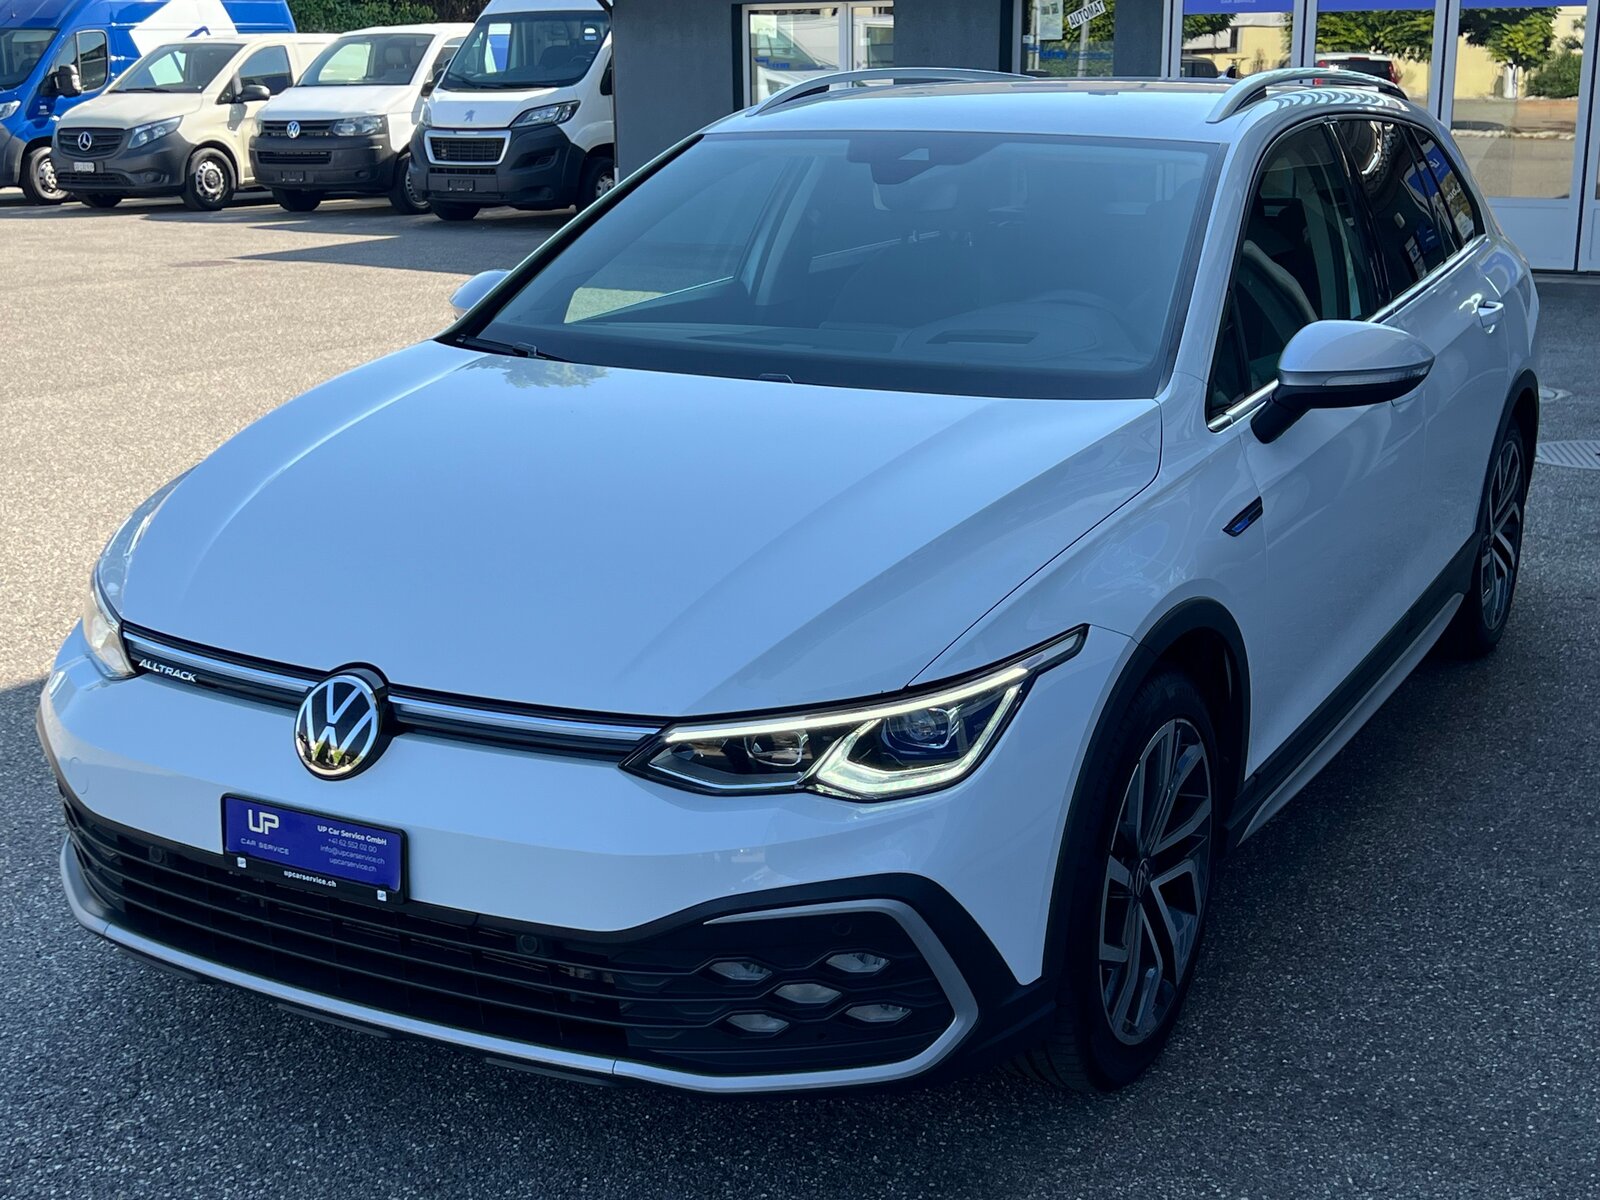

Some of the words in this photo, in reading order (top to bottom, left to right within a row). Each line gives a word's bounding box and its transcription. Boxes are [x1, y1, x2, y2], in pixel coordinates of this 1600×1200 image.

[1069, 0, 1104, 27] AUTOMAT
[139, 659, 197, 682] ALLTRACK
[248, 809, 279, 835] UP
[317, 825, 328, 833] UP
[328, 828, 340, 836] Car
[341, 830, 365, 841] Service
[366, 835, 387, 846] GmbH
[240, 838, 256, 846] CAR
[258, 842, 289, 855] SERVICE
[320, 845, 386, 865] info@upcarservice.ch
[328, 858, 377, 872] upcarservice.ch
[283, 870, 337, 888] upcarservice.ch
